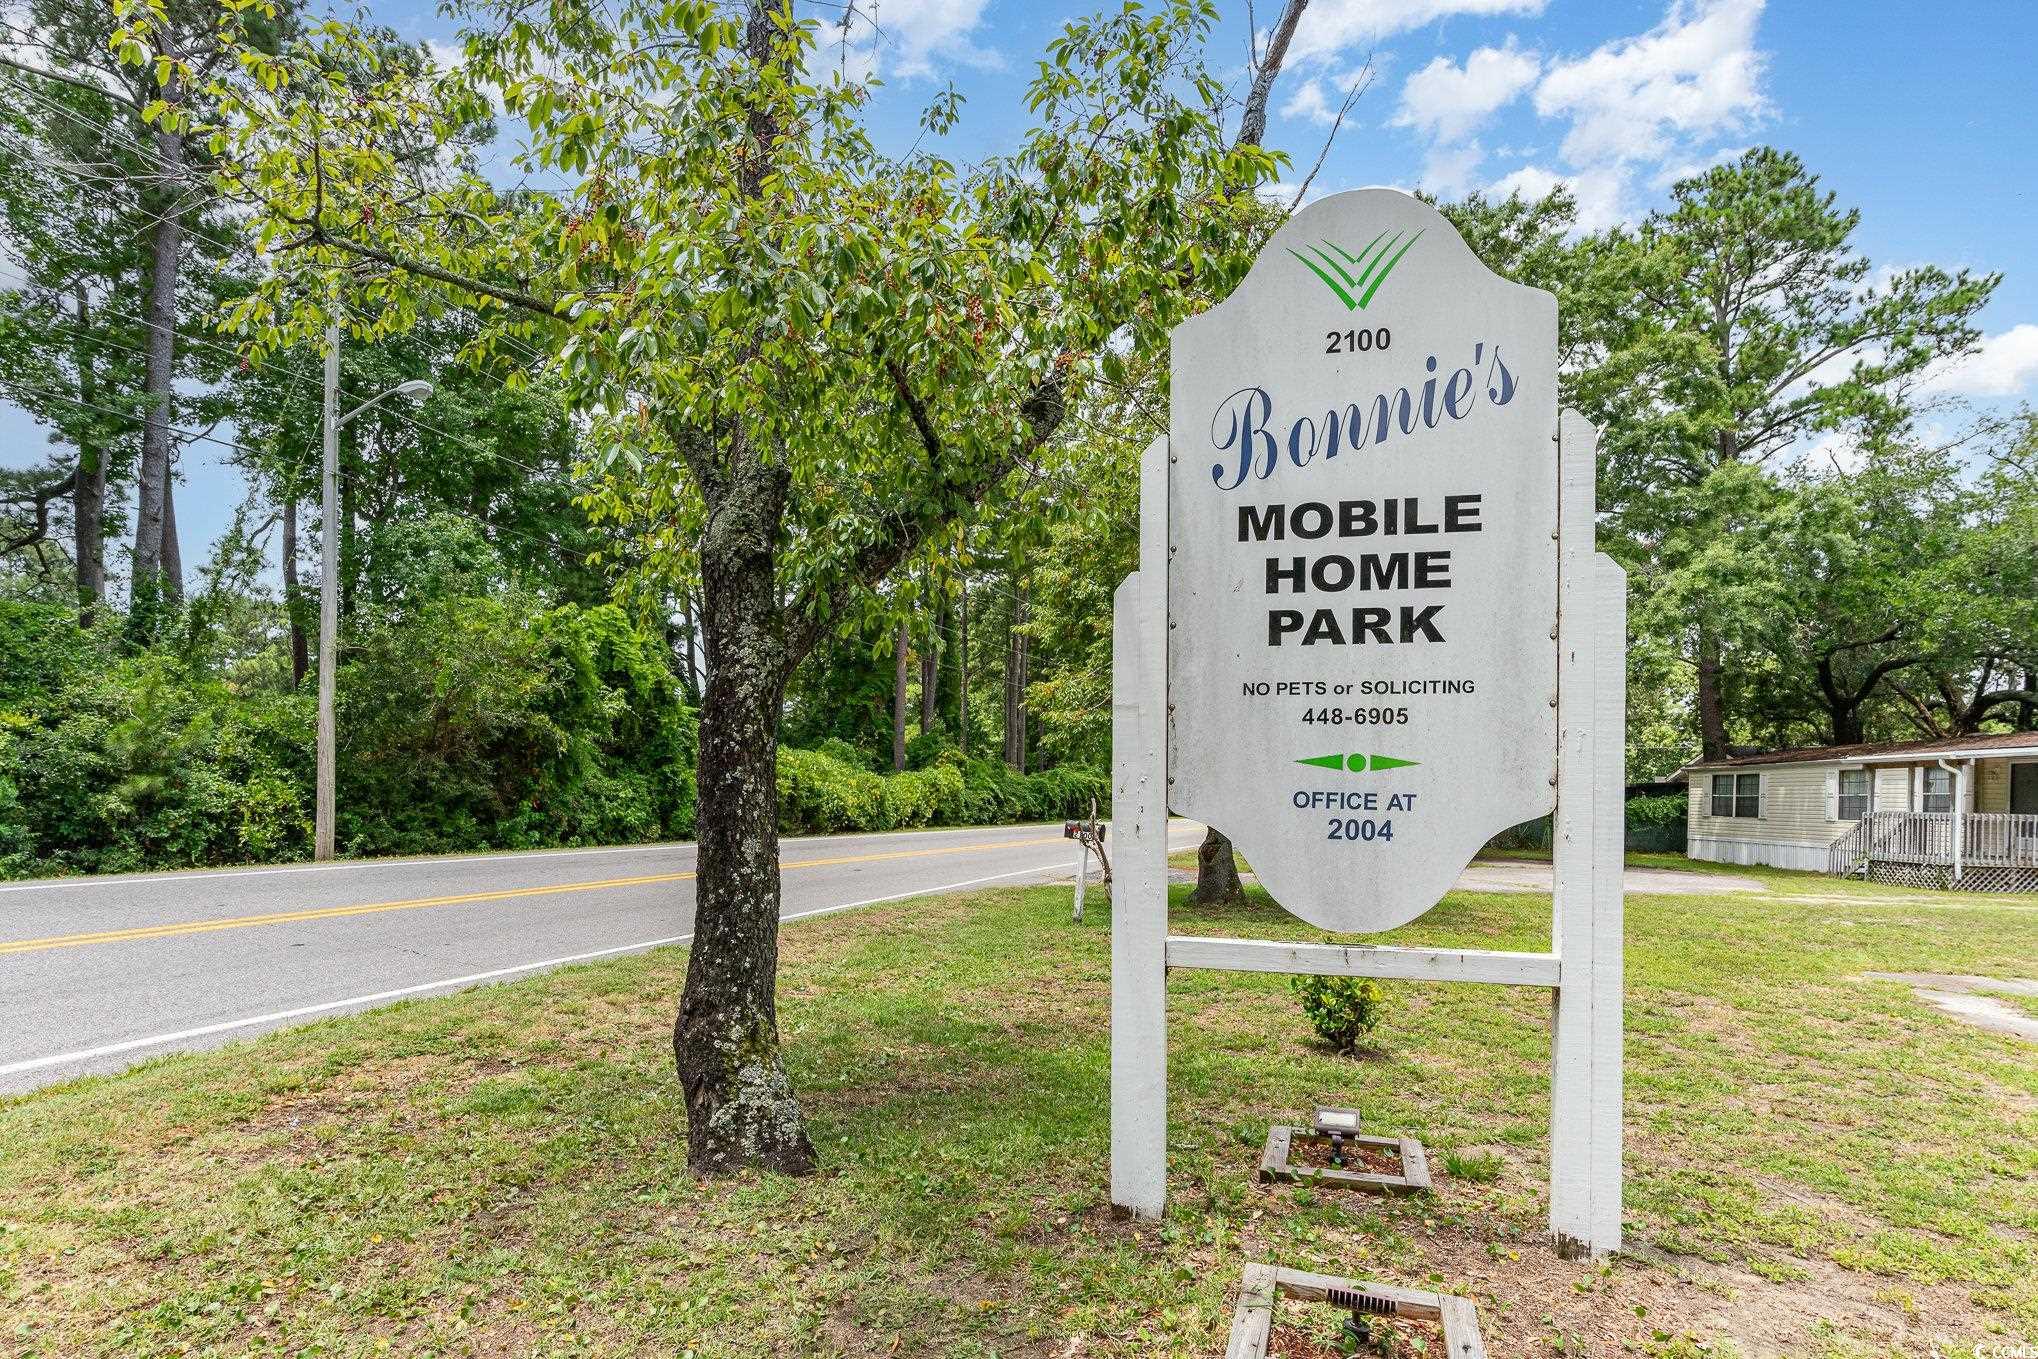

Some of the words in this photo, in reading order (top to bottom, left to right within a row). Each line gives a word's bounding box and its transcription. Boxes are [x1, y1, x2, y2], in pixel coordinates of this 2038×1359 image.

[1325, 327, 1391, 355] 2100
[1210, 342, 1519, 491] Bonnie's
[1237, 493, 1483, 543] MOBILE
[1265, 550, 1452, 595] HOME
[1267, 604, 1447, 647] PARK
[1242, 681, 1271, 697] NO
[1276, 681, 1327, 696] PETS
[1333, 684, 1354, 696] or
[1360, 679, 1475, 695] SOLICITING
[1301, 706, 1409, 726] 448-6905
[1292, 790, 1378, 811] OFFICE
[1384, 793, 1418, 812] AT
[1327, 818, 1394, 842] 2004
